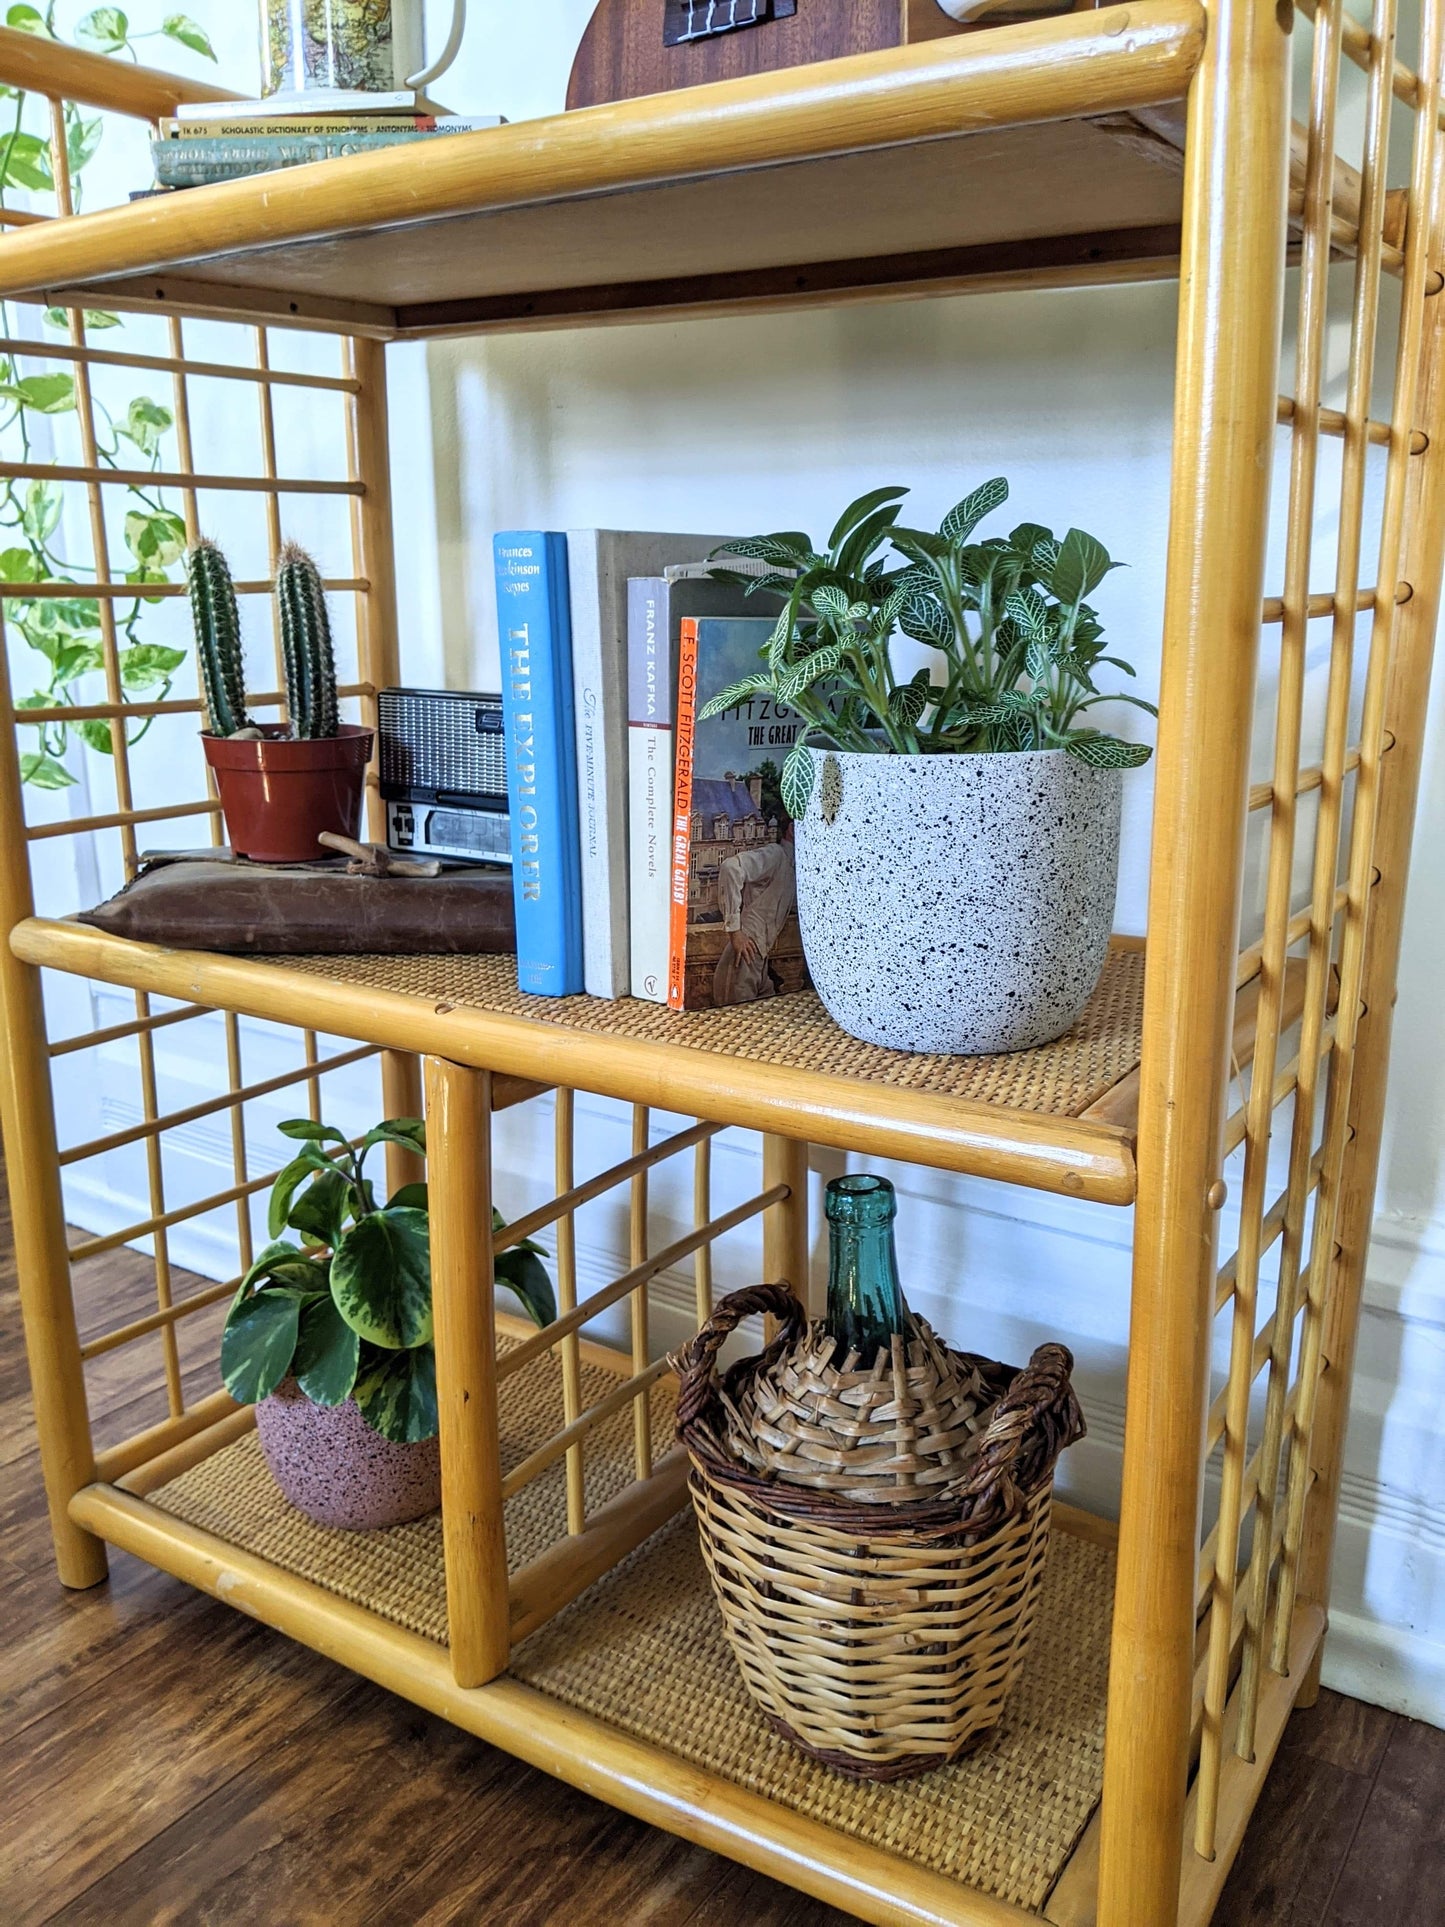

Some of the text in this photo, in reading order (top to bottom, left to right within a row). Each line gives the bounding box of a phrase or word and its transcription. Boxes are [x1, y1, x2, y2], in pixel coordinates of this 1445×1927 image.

[221, 125, 265, 135] SCHOLASTIC
[266, 125, 311, 134] DICTIONARY
[313, 125, 324, 134] OF
[326, 124, 369, 134] SYNONYMS
[375, 124, 418, 133] ANTONYMS
[426, 123, 473, 133] HOMONYMS
[645, 599, 655, 655] FRANZ
[583, 687, 597, 719] The
[646, 661, 656, 716] KAFKA
[647, 735, 656, 762] The
[676, 635, 695, 809] F. SCOTT FITZGERALD
[748, 726, 764, 746] THE
[768, 724, 799, 745] GREAT
[509, 622, 541, 902] THE EXPLORER
[646, 765, 657, 830] Complete
[647, 833, 657, 879] Novels
[672, 814, 687, 906] THE GREAT GATSBY
